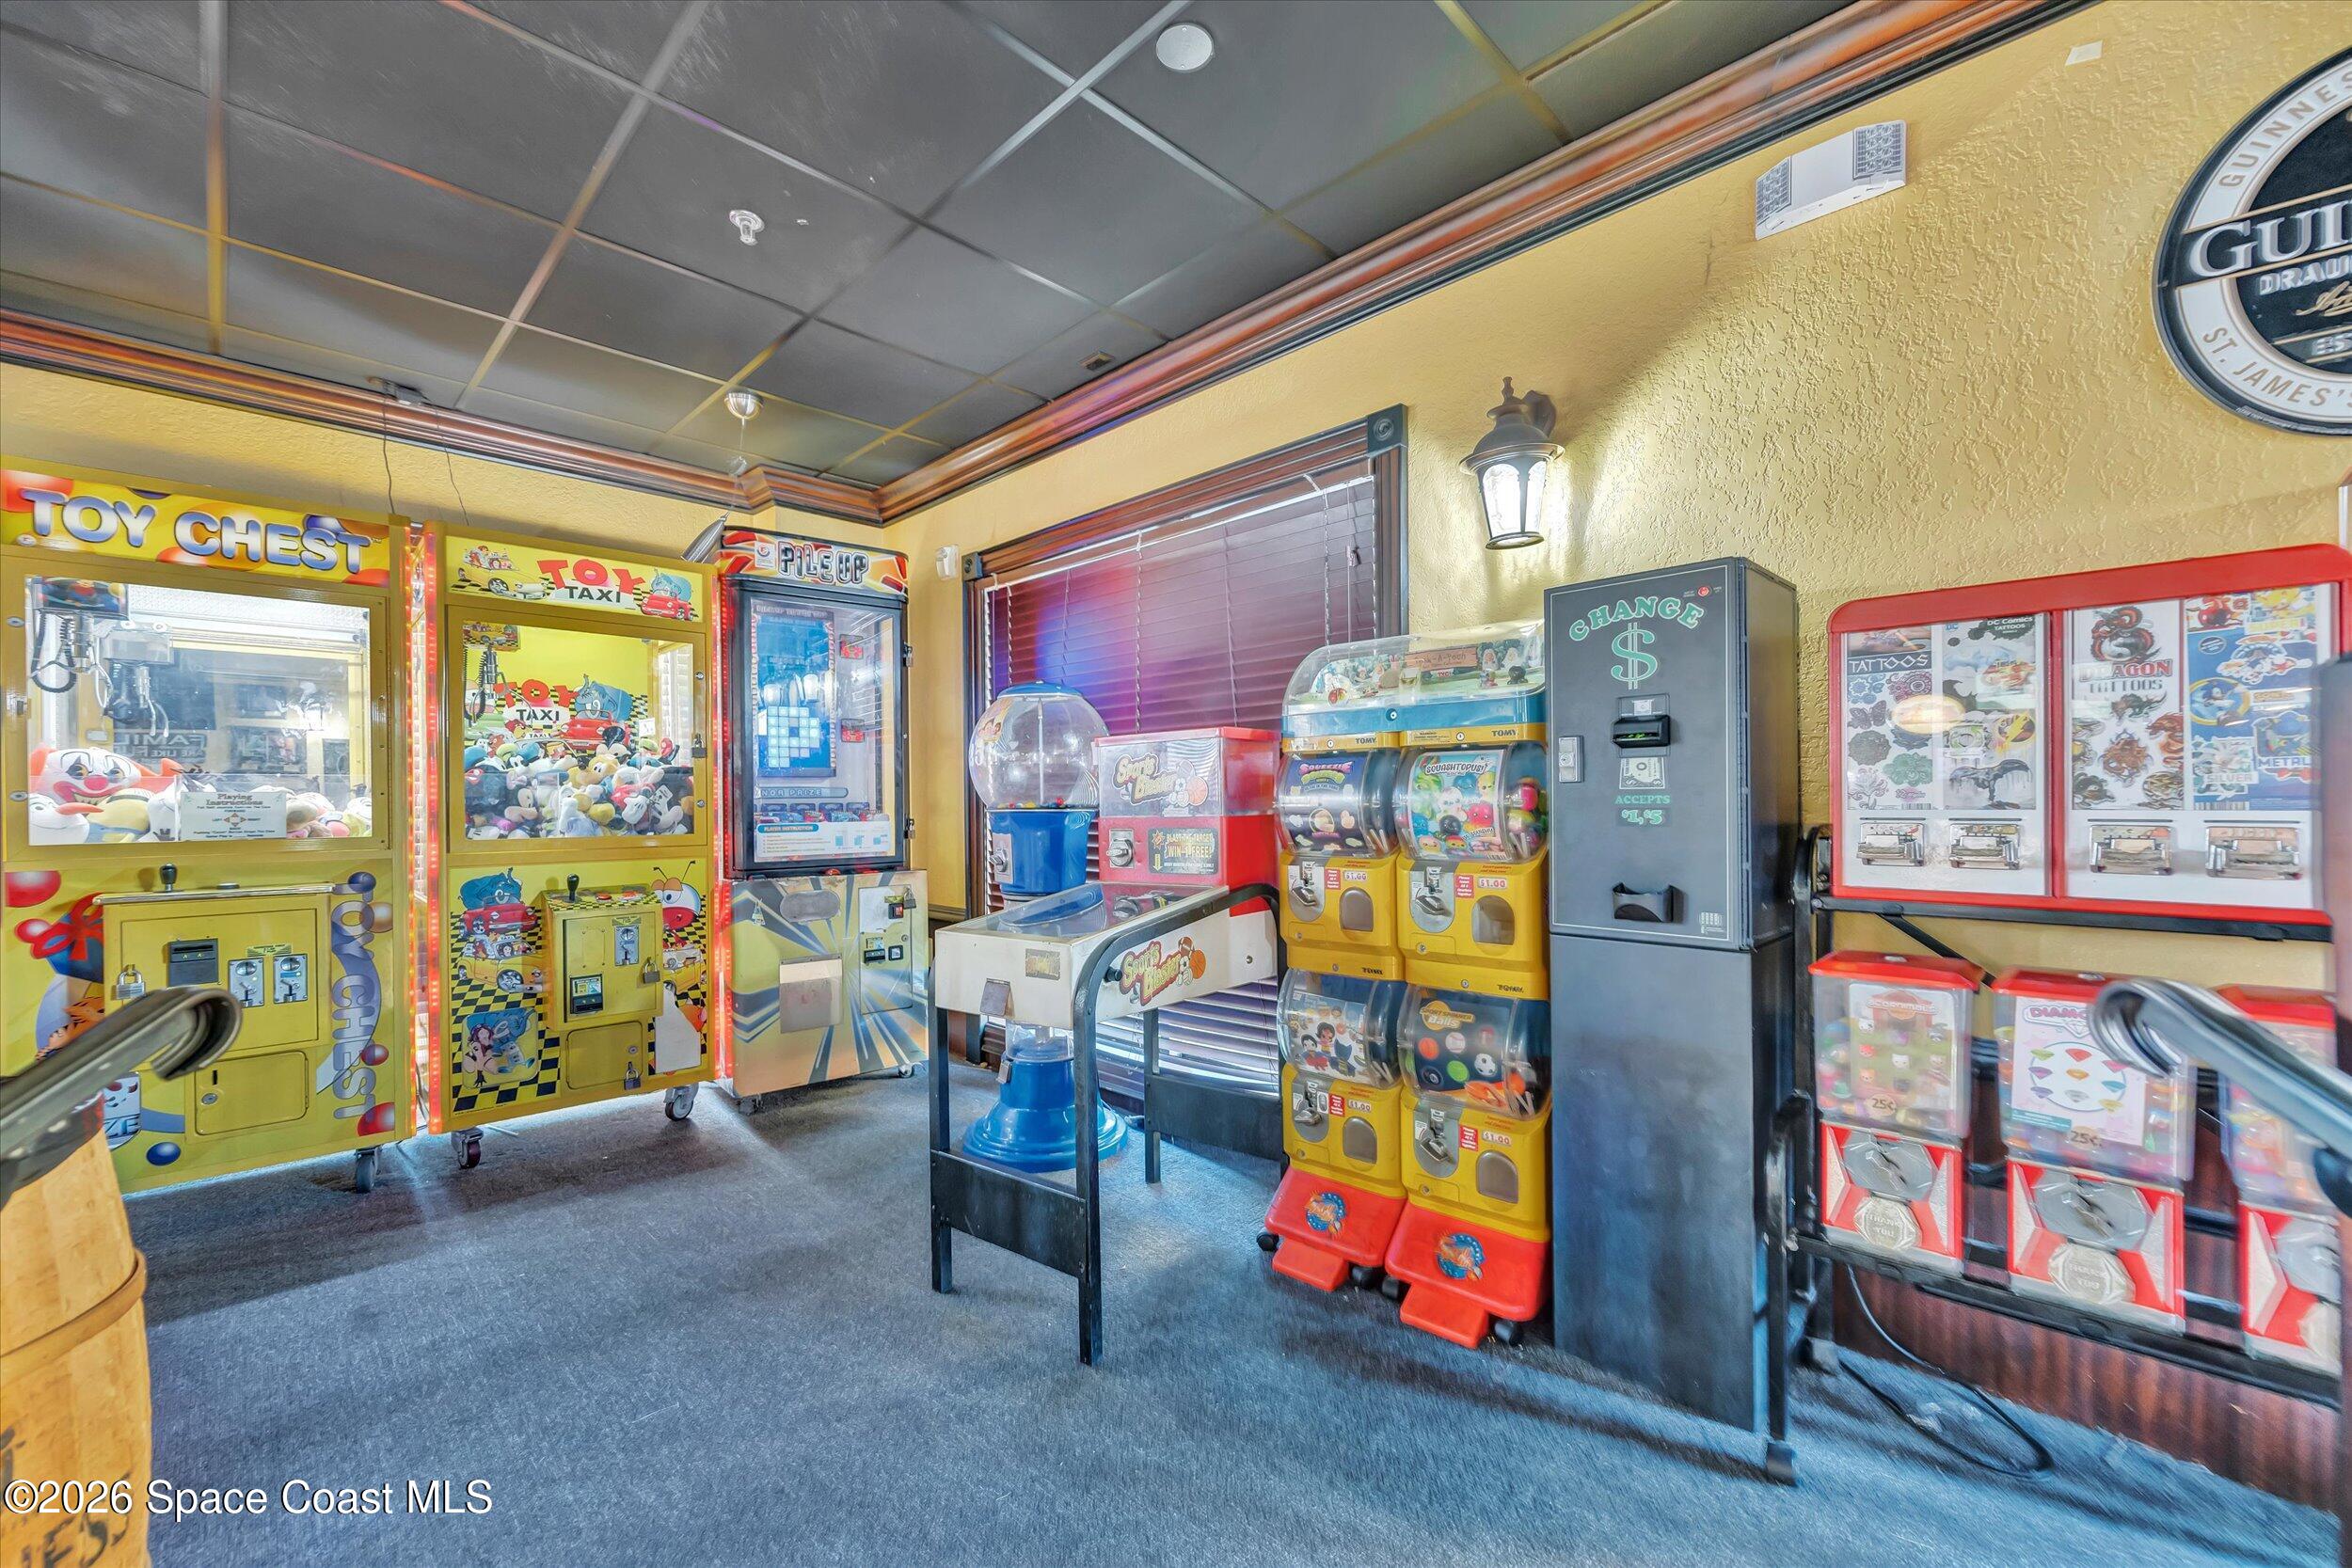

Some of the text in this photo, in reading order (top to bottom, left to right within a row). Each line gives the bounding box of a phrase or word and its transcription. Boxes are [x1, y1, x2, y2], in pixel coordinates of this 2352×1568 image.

[2189, 198, 2352, 277] GUI
[2260, 255, 2352, 295] DRAU
[2202, 326, 2352, 407] ST. JAMES'
[20, 488, 371, 573] TOY CHEST
[537, 559, 646, 595] TOY
[778, 541, 869, 584] PILE UP
[564, 586, 621, 603] TAXI
[1568, 595, 1705, 641] CHANGE
[1611, 622, 1659, 690] $
[1849, 654, 1929, 673] TATTOOS
[493, 678, 580, 708] TOY
[516, 708, 560, 721] TAXI
[1115, 754, 1158, 786] Sports
[1615, 795, 1671, 805] ACCEPTS
[1121, 943, 1160, 990] Sports
[1140, 954, 1181, 1002] Blaster
[332, 883, 377, 1119] TOY CHEST
[1427, 1014, 1461, 1028] Balls
[1350, 1101, 1371, 1111] $1.00
[1485, 1132, 1510, 1145] $1.00
